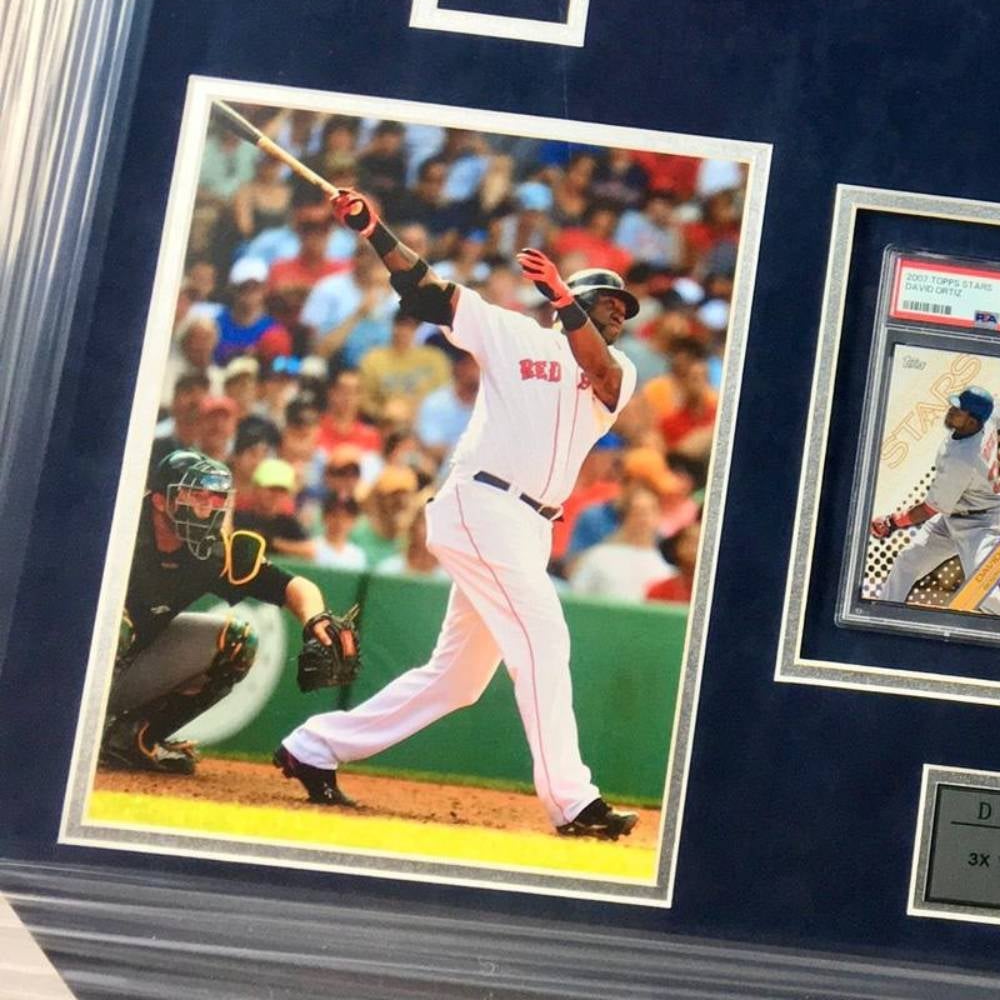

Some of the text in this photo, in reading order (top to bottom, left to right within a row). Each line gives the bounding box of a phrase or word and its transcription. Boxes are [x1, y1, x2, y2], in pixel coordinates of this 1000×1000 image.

[905, 282, 962, 298] DAVID ORTIZ
[931, 275, 960, 288] TOPPS
[962, 280, 992, 292] STARS
[520, 358, 561, 383] RED
[880, 354, 982, 469] STARS
[968, 852, 991, 868] 3X
